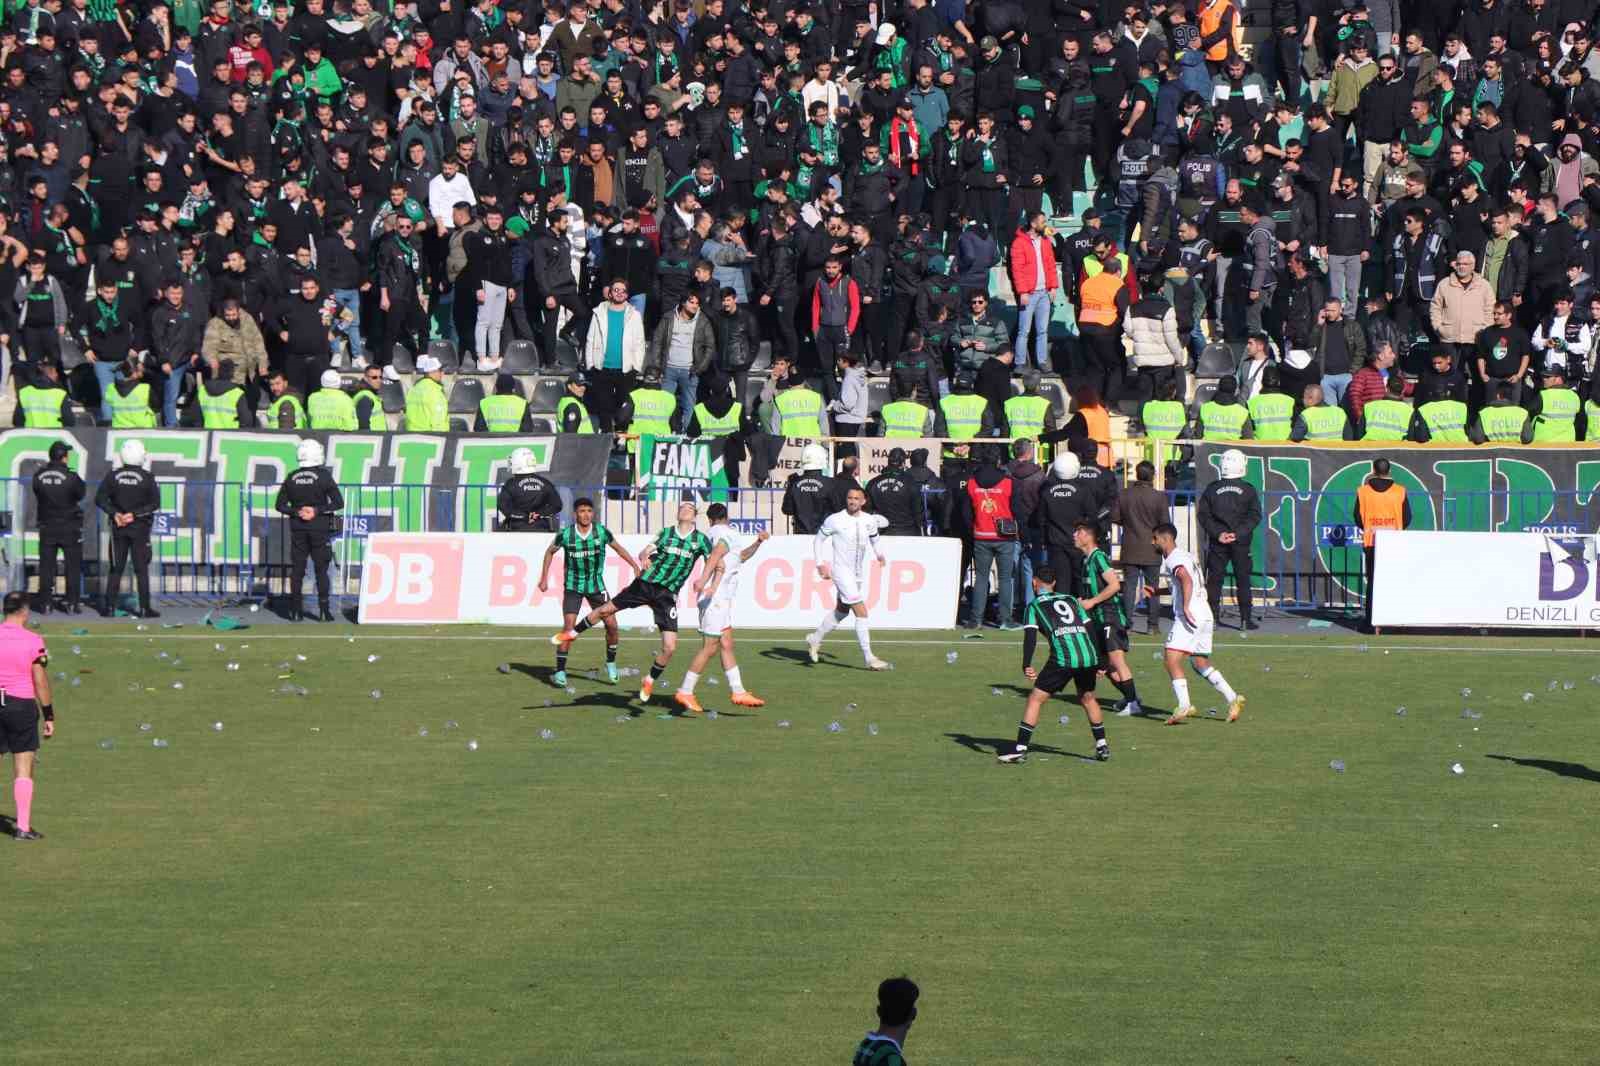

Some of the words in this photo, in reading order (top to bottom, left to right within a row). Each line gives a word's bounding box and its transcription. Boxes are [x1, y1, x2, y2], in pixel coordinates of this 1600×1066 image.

[653, 442, 711, 479] FANA
[670, 606, 678, 620] 6
[1053, 600, 1075, 624] 9
[1506, 605, 1578, 622] DENİZLİ
